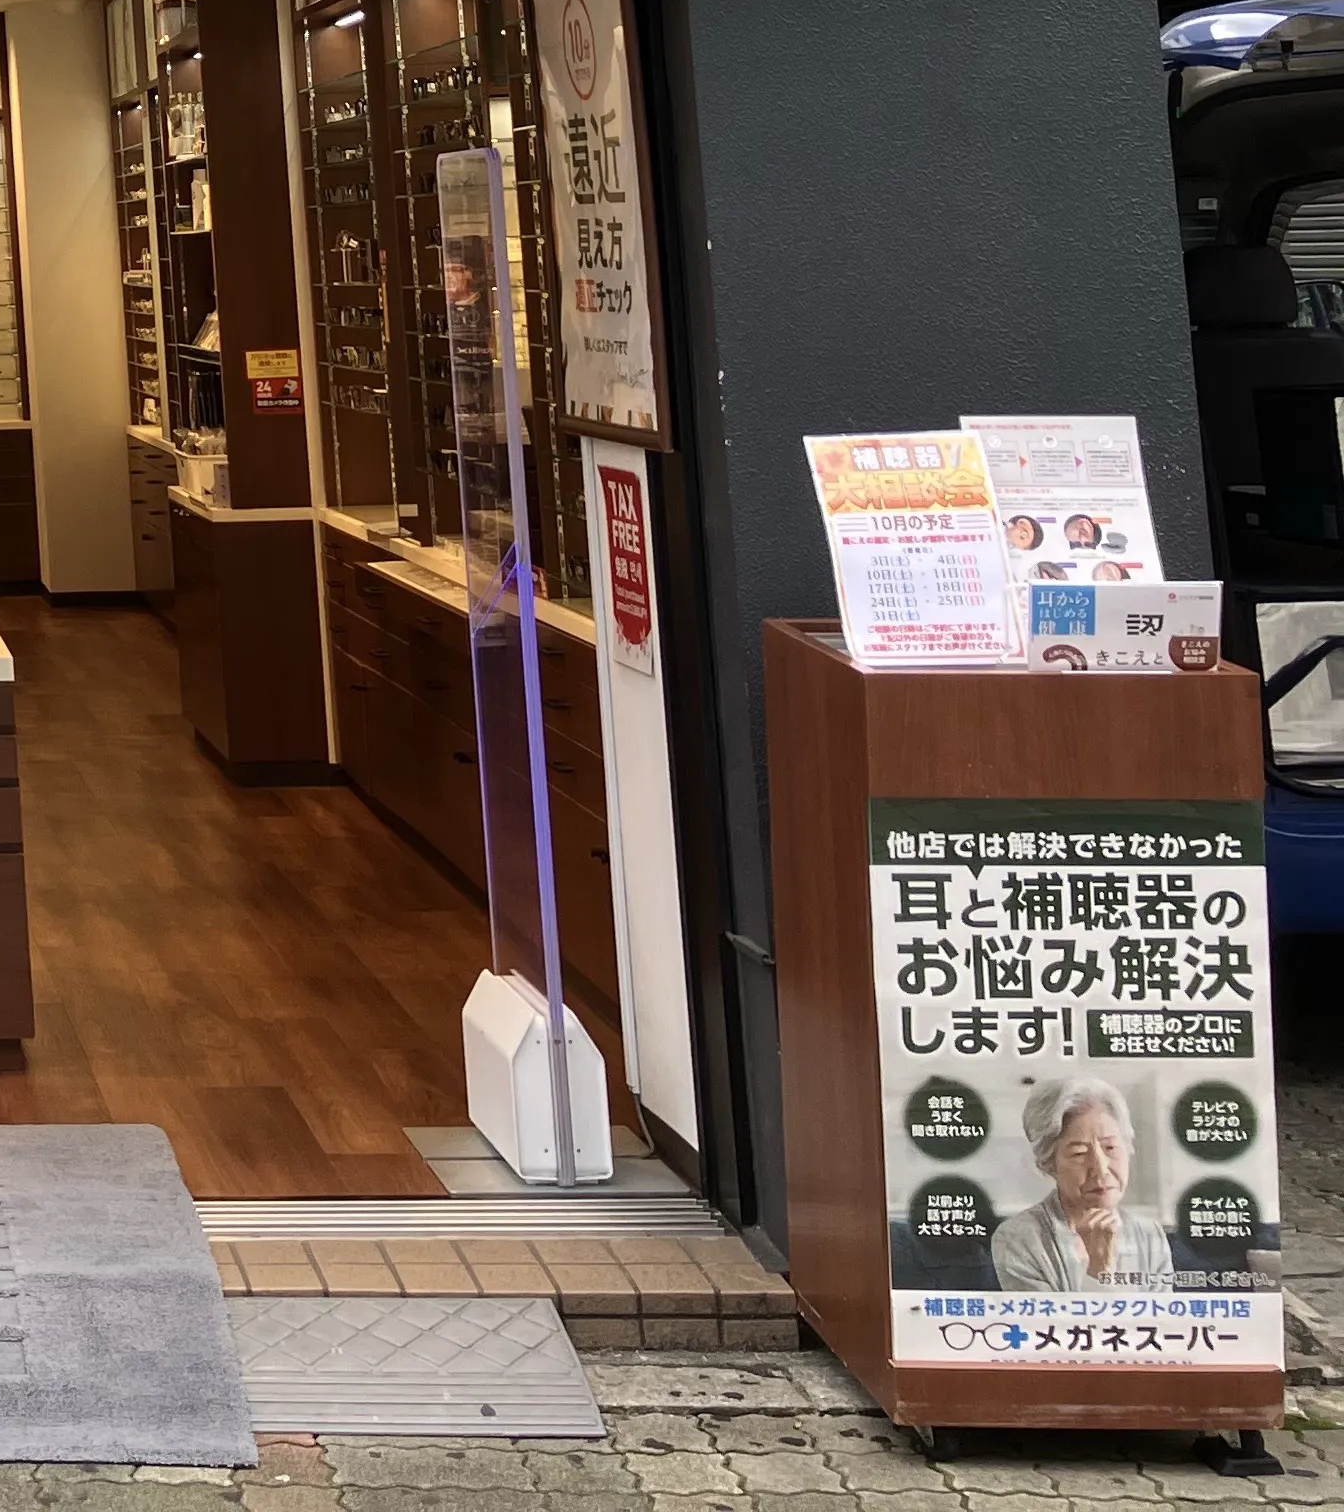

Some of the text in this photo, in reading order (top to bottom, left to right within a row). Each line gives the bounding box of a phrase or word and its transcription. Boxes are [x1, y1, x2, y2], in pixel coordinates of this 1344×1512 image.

[577, 216, 624, 270] 見え方
[852, 445, 941, 470] 補聴器
[825, 470, 990, 510] 大相談会
[608, 481, 637, 522] TAX
[871, 514, 954, 532] 10月の予定
[612, 519, 641, 556] FREE
[1037, 591, 1090, 608] 耳から
[1096, 649, 1164, 667] きこえと
[887, 831, 1243, 860] 他店では解決できなかった
[892, 872, 1247, 930] 耳と補聴器の
[897, 935, 1254, 1001] お悩み解決
[1100, 1014, 1242, 1035] 補聴器のプロに
[928, 1096, 964, 1110] 会話を
[1191, 1101, 1239, 1114] テレビや
[931, 1110, 963, 1123] うまく
[1192, 1115, 1240, 1128] ラジオの
[912, 1124, 984, 1138] 聞き取れない
[1186, 1129, 1248, 1143] 音が大きい
[928, 1195, 974, 1208] 以前より
[1191, 1197, 1249, 1210] チャイムや
[926, 1209, 976, 1223] 話す声が
[1189, 1211, 1250, 1224] 電話の音に
[918, 1223, 987, 1238] 大きくなった
[1189, 1225, 1252, 1238] 気づかない
[925, 1297, 1251, 1319] 補聴器・メガネ・コンタクトの専門店
[1034, 1324, 1240, 1352] メガネスーパー
